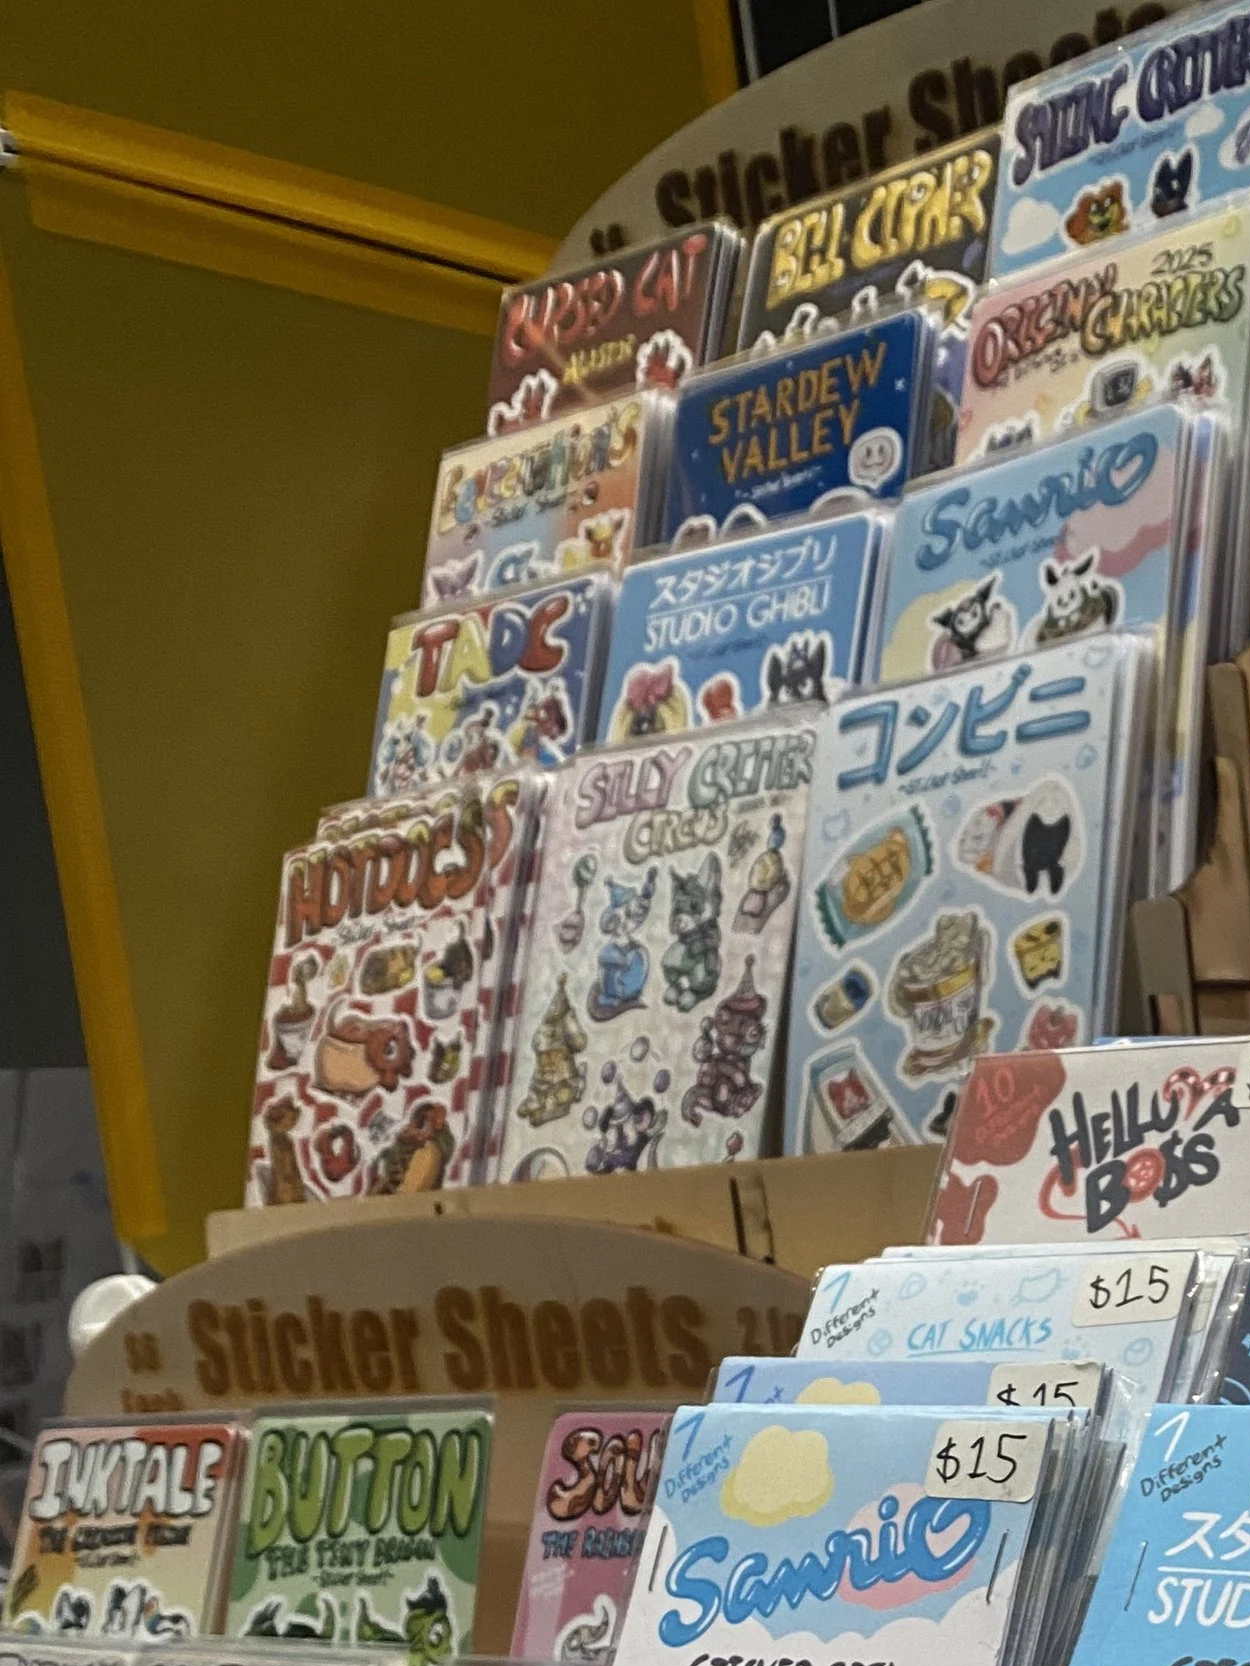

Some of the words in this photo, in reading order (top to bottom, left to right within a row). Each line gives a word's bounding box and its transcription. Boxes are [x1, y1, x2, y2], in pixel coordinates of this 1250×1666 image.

[850, 149, 993, 271] CIPHER
[632, 233, 709, 316] CAT
[1151, 244, 1214, 275] 2025
[707, 341, 888, 446] STARDEW
[721, 398, 860, 484] VALLEY
[914, 431, 1158, 572] Sanrio
[648, 533, 839, 610] スタジオジブリ
[411, 594, 571, 698] TADC
[643, 602, 738, 652] STUDIO
[746, 578, 832, 629] GHIBLI
[574, 745, 694, 830] SILLY
[687, 728, 818, 810] CRITTER
[623, 807, 729, 866] CIRCUS
[1088, 1265, 1170, 1309] $15
[187, 1293, 421, 1397] Sticker
[434, 1284, 712, 1392] Sheets
[906, 1319, 950, 1352] CAT
[958, 1315, 1053, 1352] SNACKS
[29, 1436, 224, 1523] INKTALE
[244, 1422, 483, 1561] BUTTON
[935, 1432, 1027, 1484] $15
[658, 1495, 992, 1647] Sanrio
